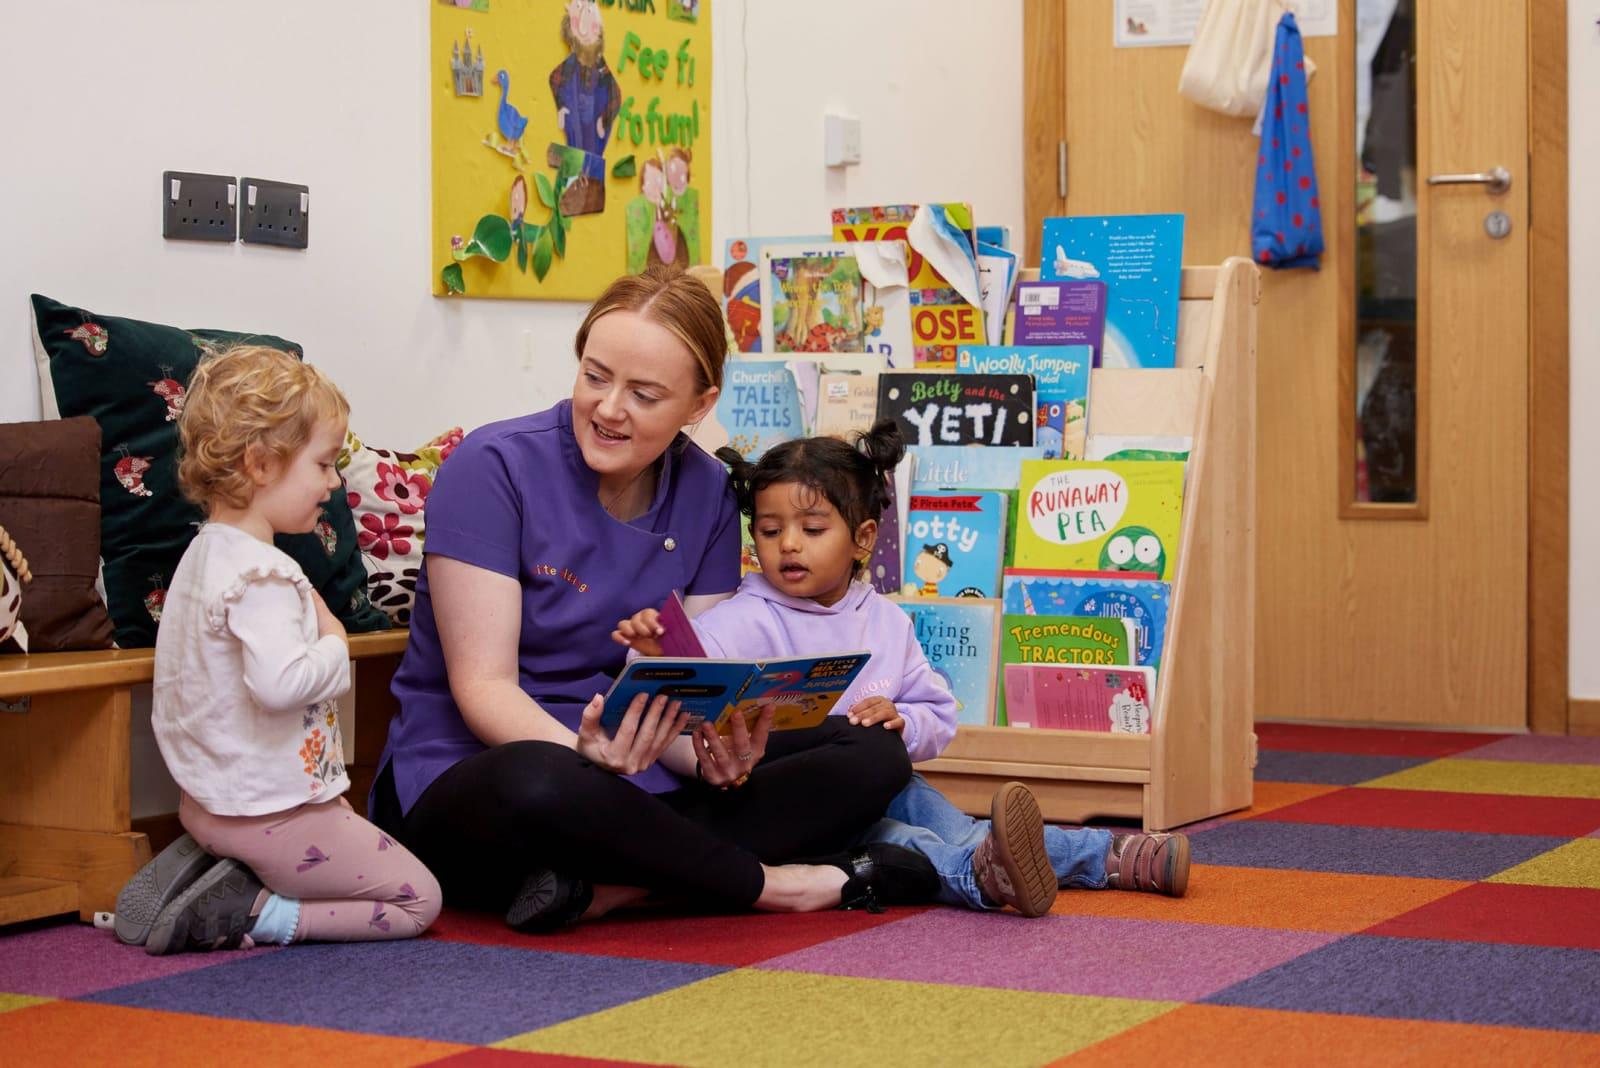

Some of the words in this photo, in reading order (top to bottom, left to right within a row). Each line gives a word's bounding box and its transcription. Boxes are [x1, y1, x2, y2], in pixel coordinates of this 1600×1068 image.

[617, 31, 669, 81] Fee
[617, 95, 643, 147] fo
[915, 309, 976, 341] OSE
[972, 352, 1026, 375] Woolly
[1026, 353, 1081, 376] Jumper
[732, 386, 781, 404] TALE
[911, 380, 960, 402] Betty
[964, 386, 986, 397] and
[988, 388, 1005, 400] the
[731, 408, 792, 428] TAILS
[902, 402, 1007, 446] YETI
[1050, 475, 1070, 486] THE
[1031, 480, 1121, 518] RUNAWAY
[1057, 510, 1106, 541] PEA
[919, 618, 970, 645] lying
[1010, 623, 1120, 648] Tremendous
[920, 643, 977, 662] nguin
[1019, 644, 1115, 665] TRACTORS
